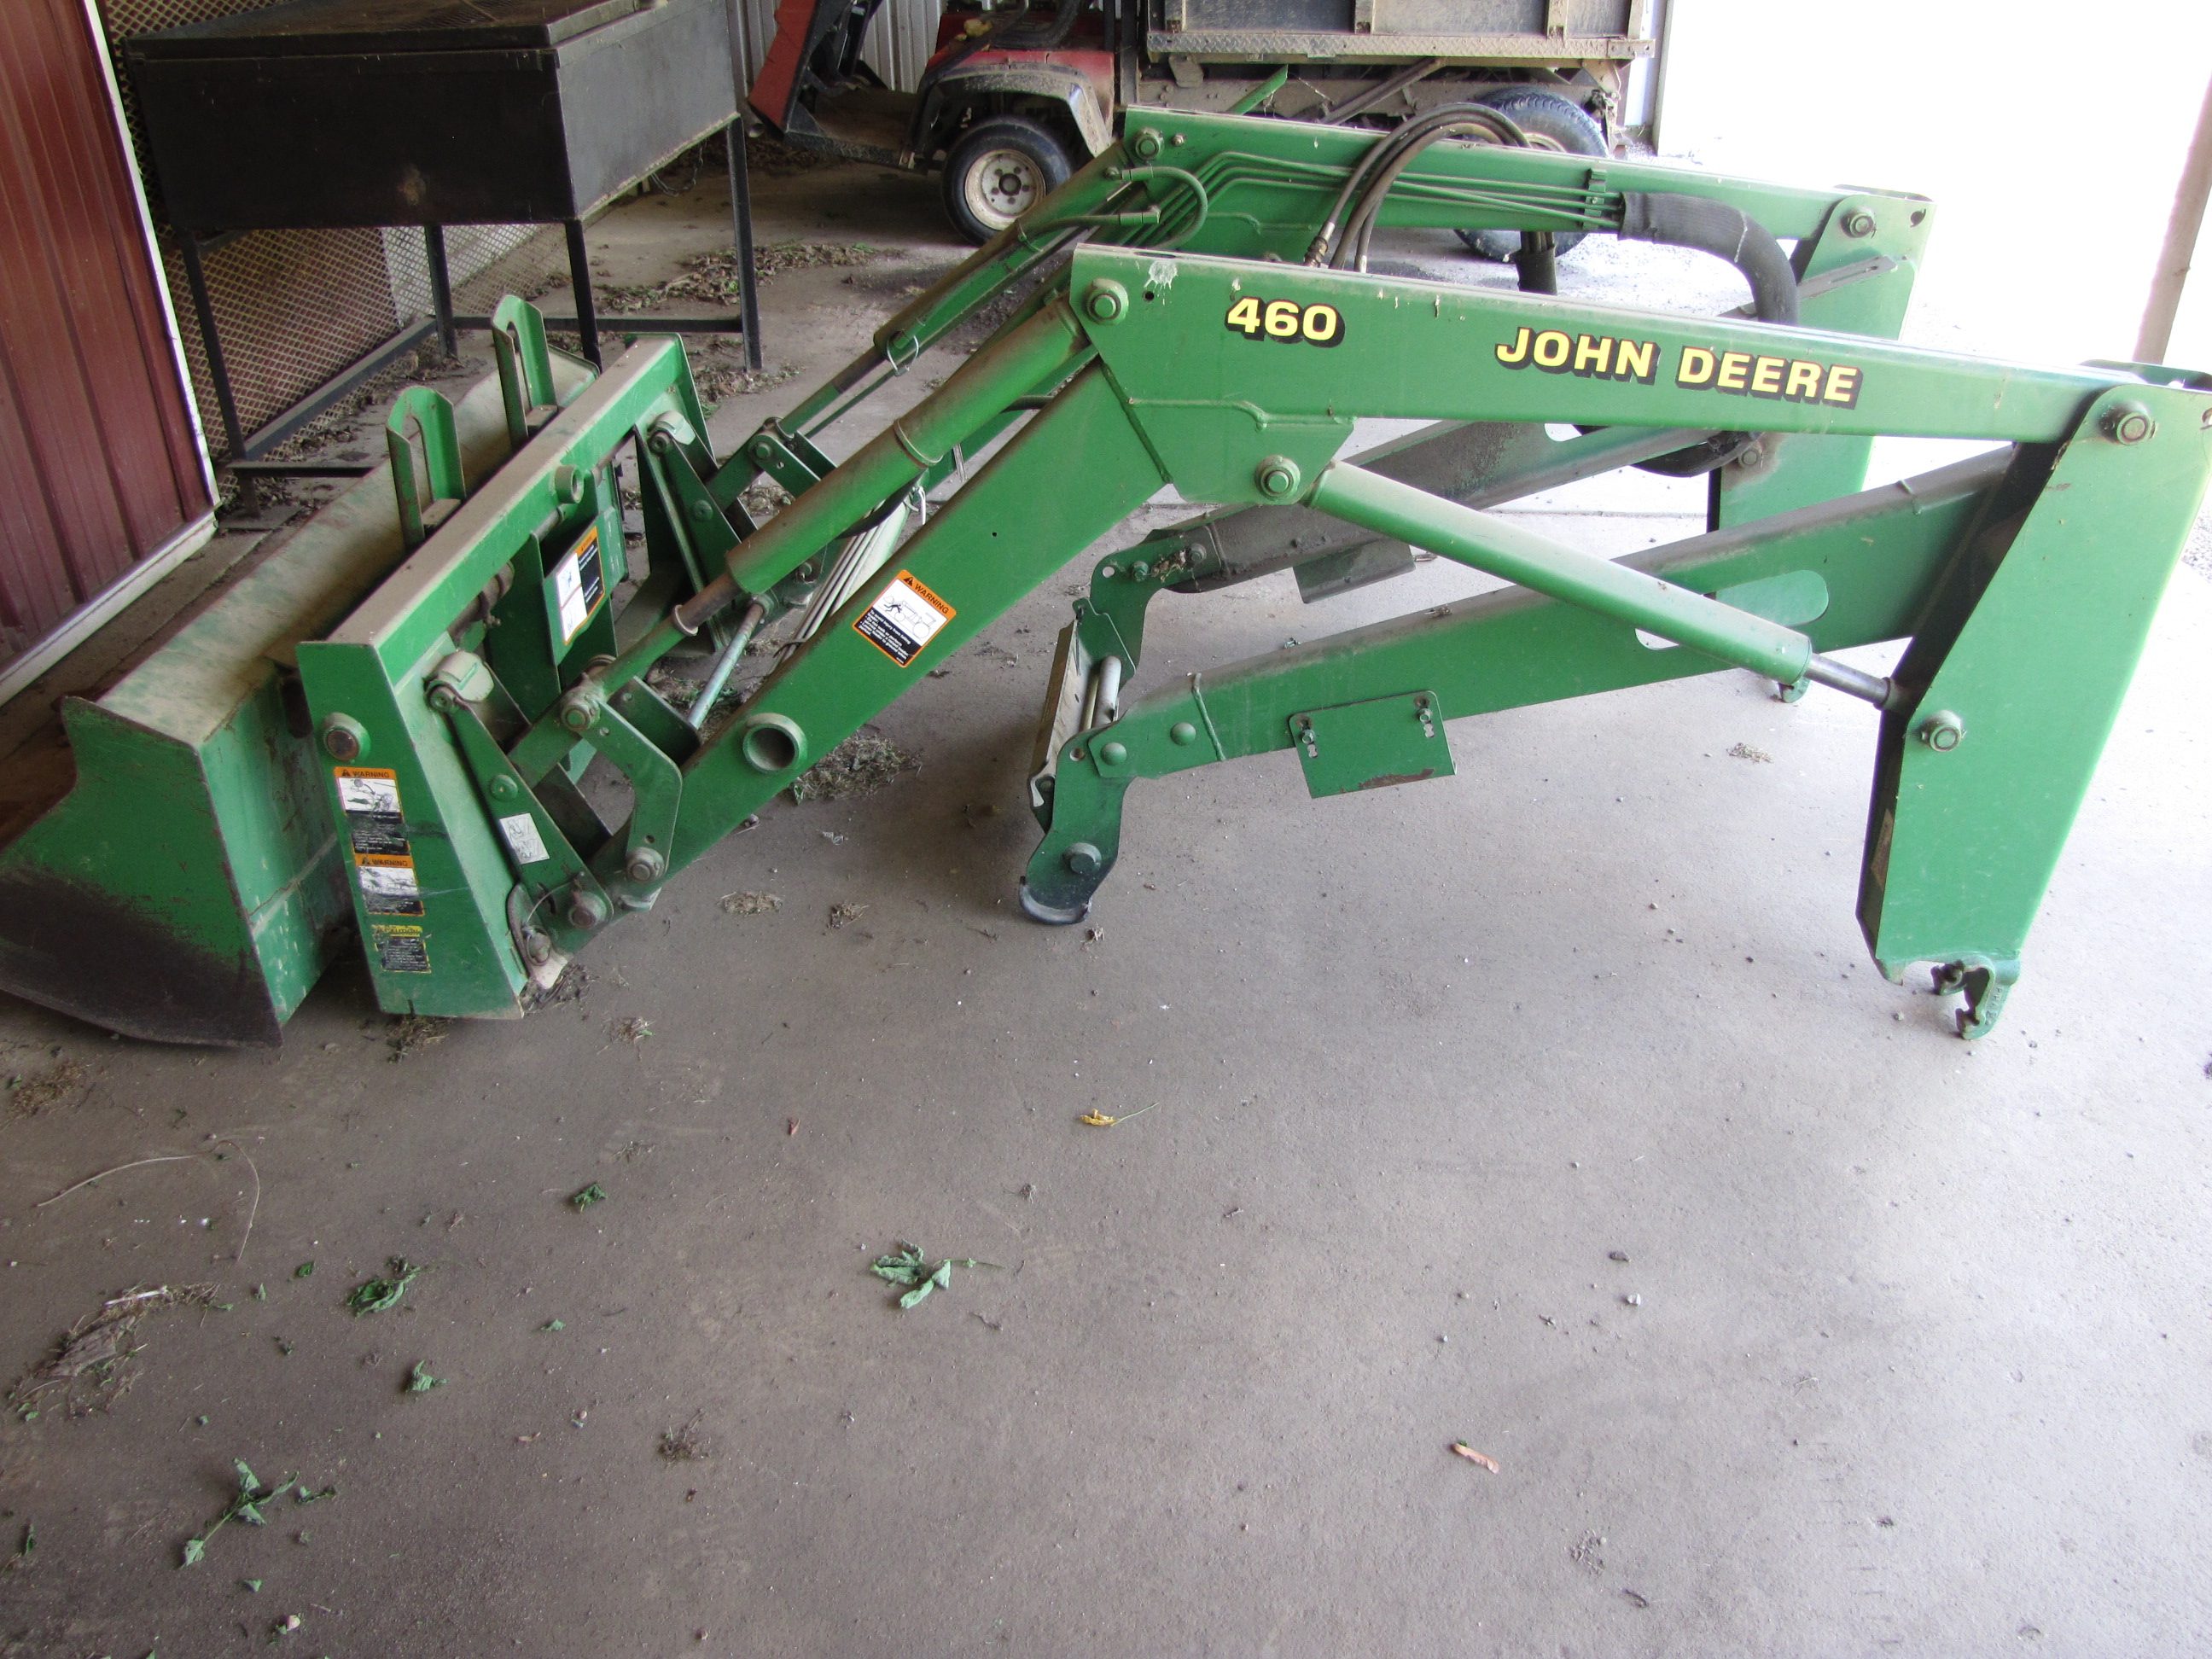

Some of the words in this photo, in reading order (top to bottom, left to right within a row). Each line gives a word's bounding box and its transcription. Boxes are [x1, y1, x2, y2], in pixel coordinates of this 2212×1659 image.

[1225, 296, 1343, 346] 460
[1496, 327, 1659, 382] JOHN
[1677, 346, 1862, 409] DEERE
[915, 584, 949, 614] WARNING
